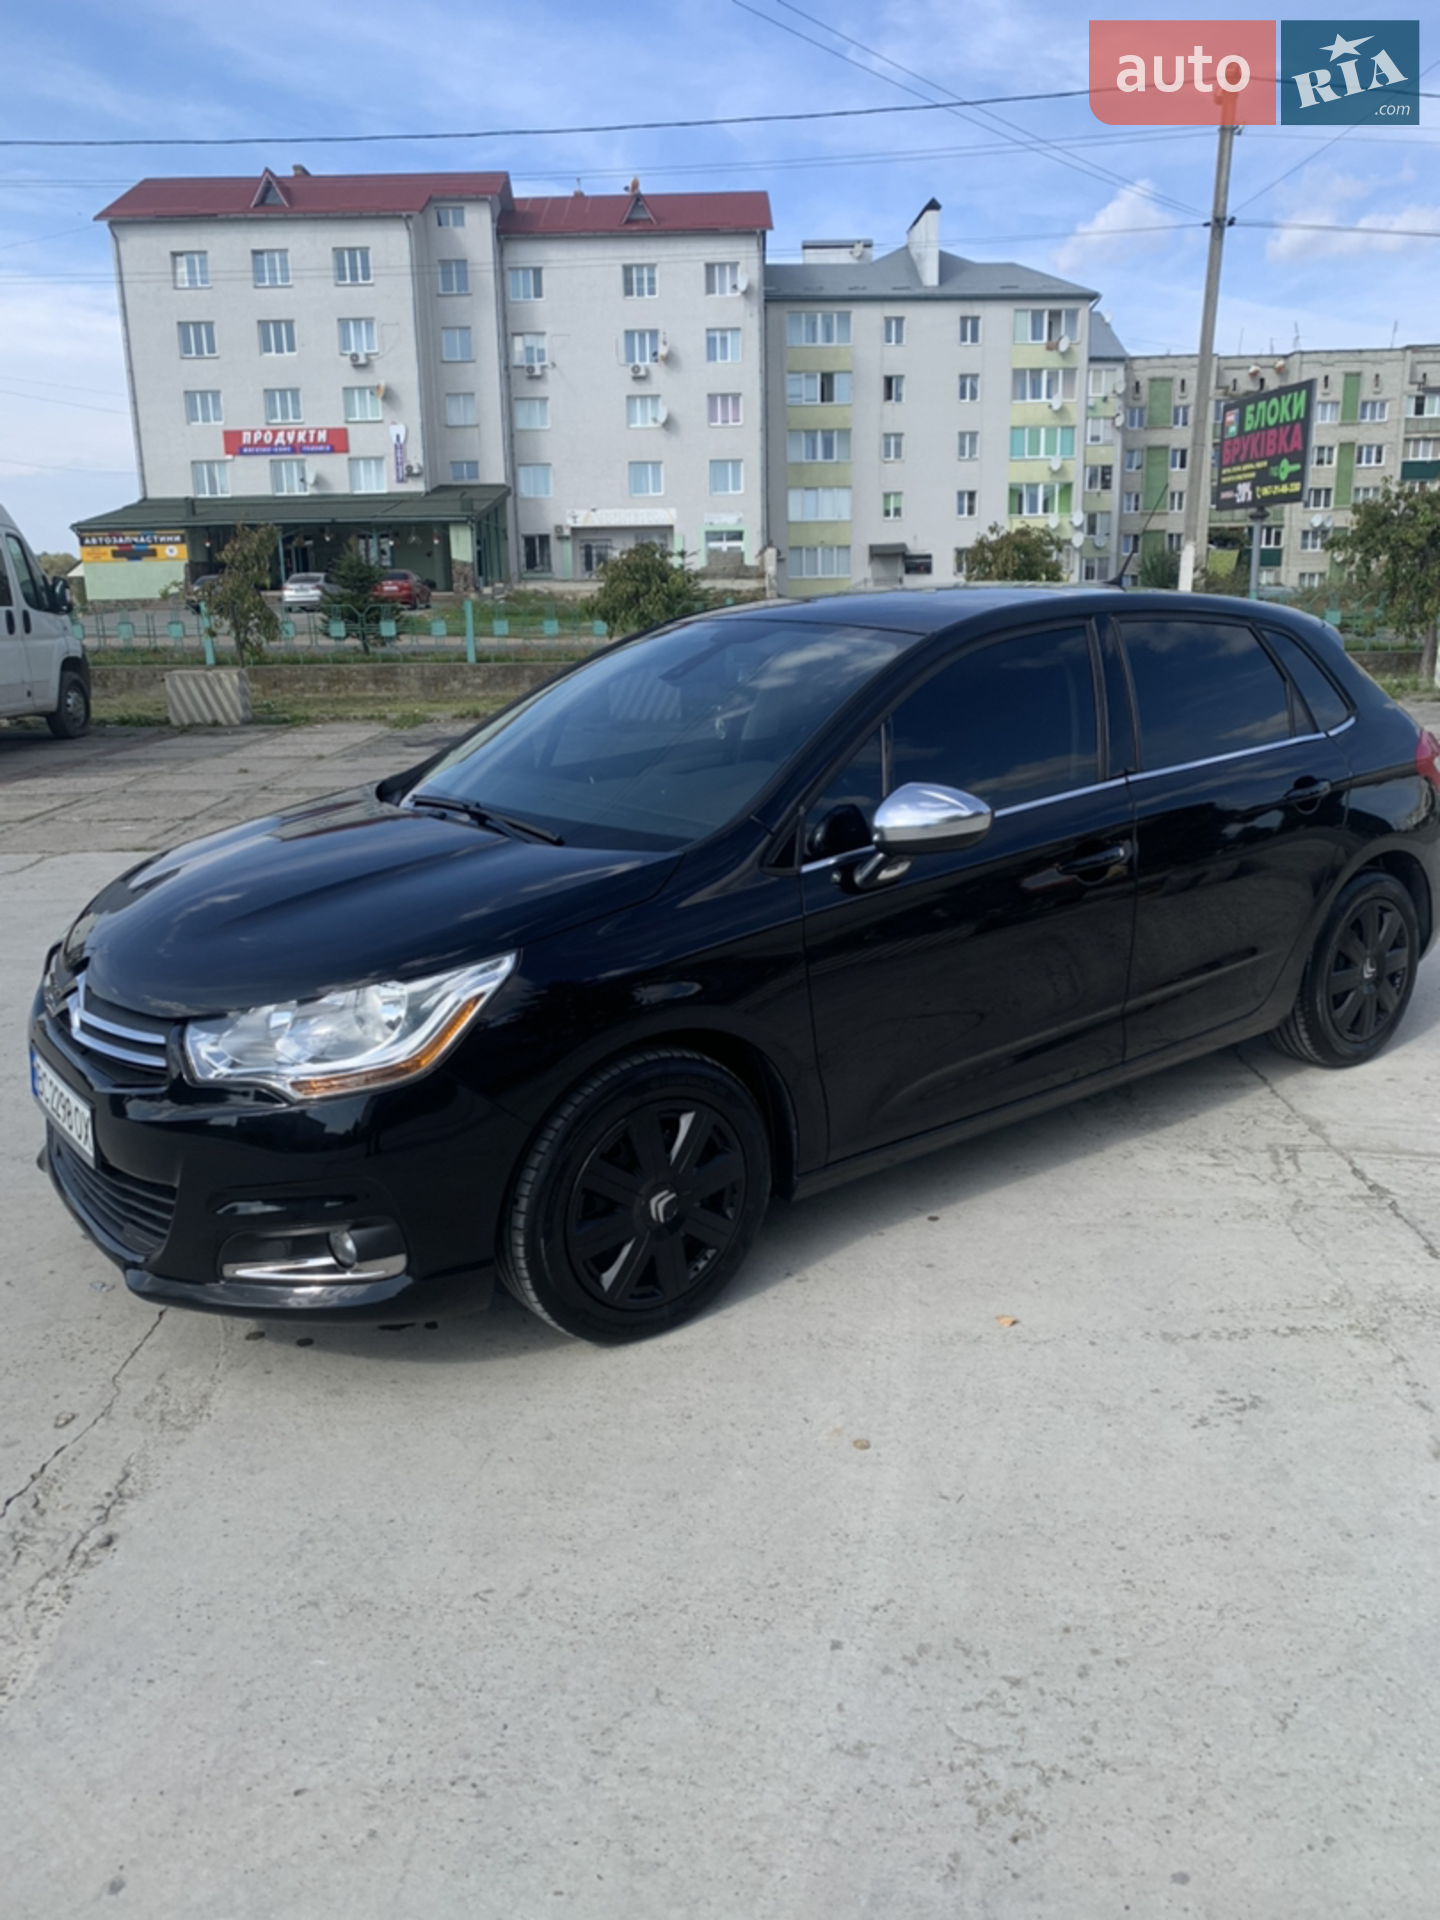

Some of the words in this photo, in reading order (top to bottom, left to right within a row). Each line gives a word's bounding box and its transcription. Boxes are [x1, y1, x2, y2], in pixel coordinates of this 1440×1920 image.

[1244, 390, 1306, 431] БЛОКИ
[242, 430, 328, 445] ПРОДУКТИ
[1222, 423, 1302, 466] БРУКІВКА
[84, 535, 181, 545] АВТОЗАПЧАСТИНИ
